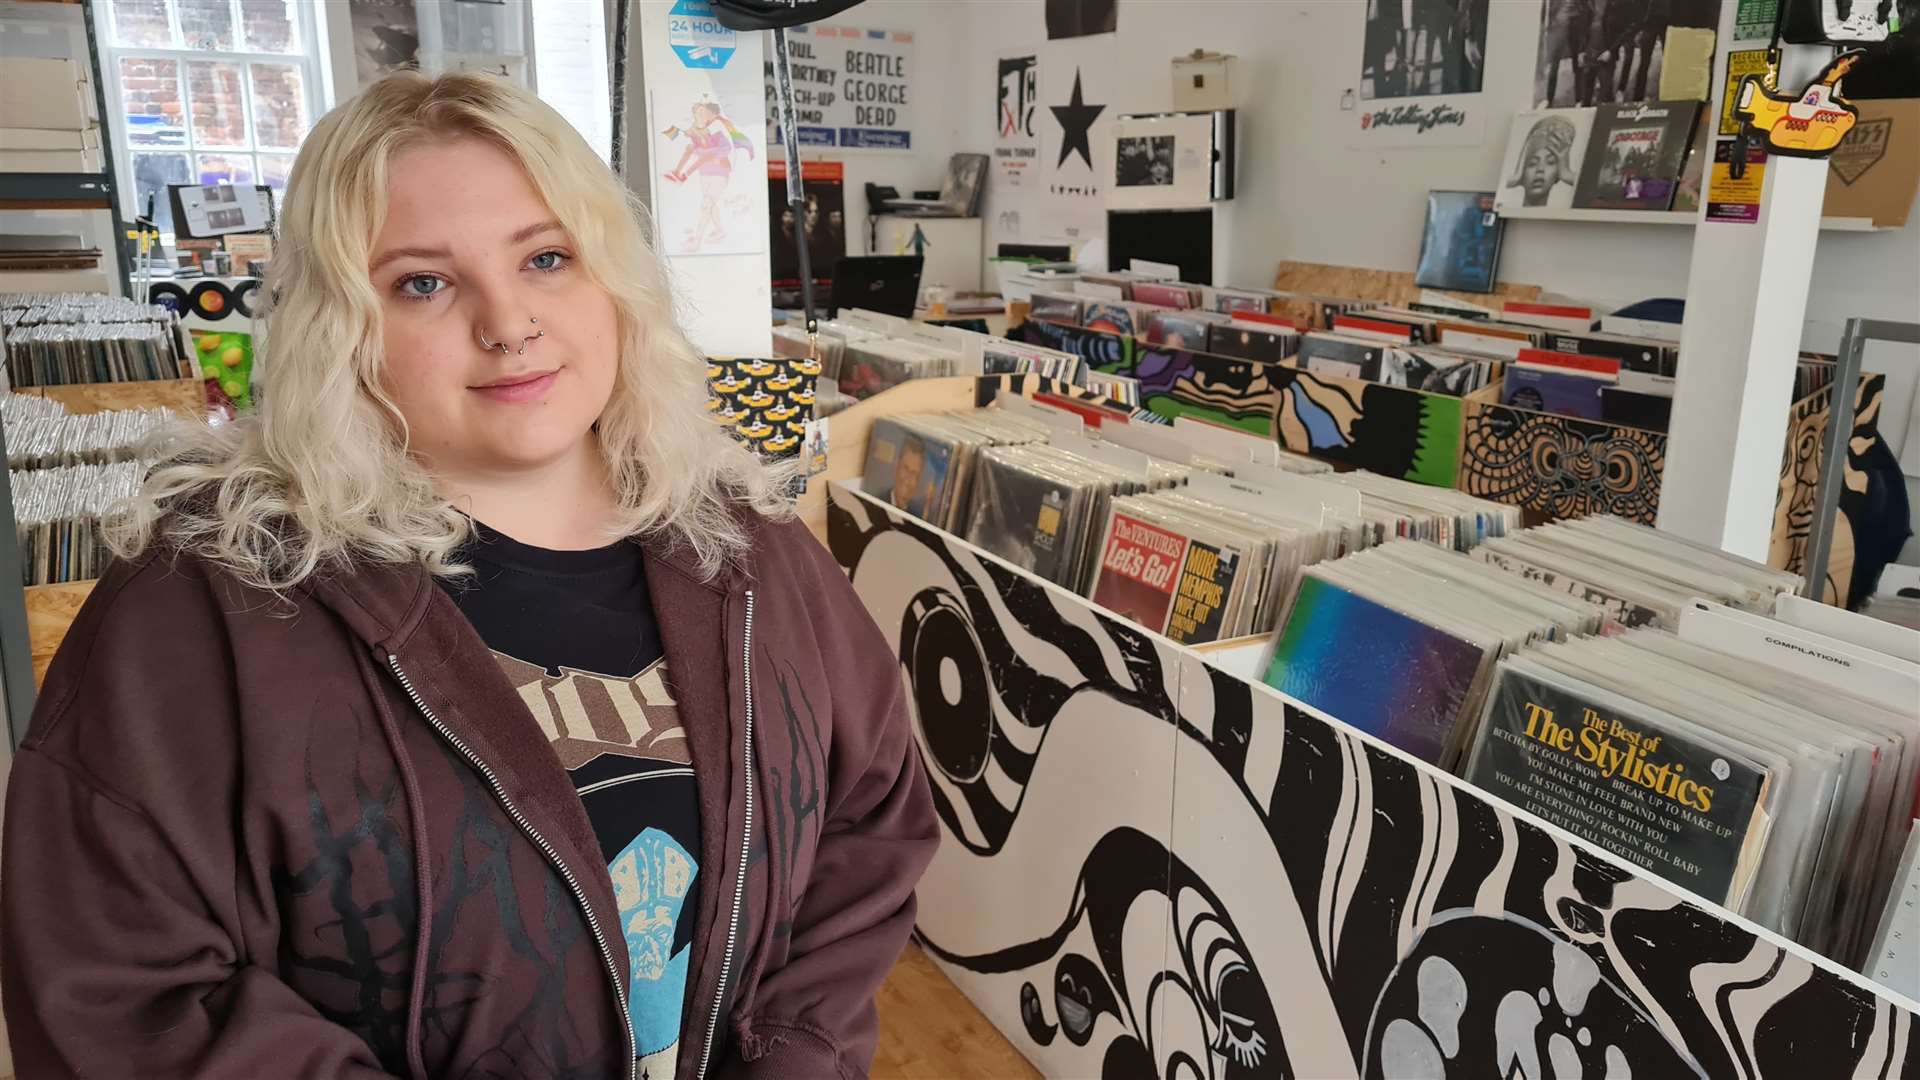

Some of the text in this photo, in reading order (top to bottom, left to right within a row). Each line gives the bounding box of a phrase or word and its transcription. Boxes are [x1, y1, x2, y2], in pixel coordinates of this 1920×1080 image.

[671, 20, 688, 32] 24
[788, 40, 816, 59] AUL
[846, 50, 905, 77] BEATLE
[844, 78, 907, 105] GEORGE
[856, 105, 897, 127] DEAD
[1115, 519, 1182, 559] The VENTURES
[1105, 540, 1177, 589] Let's Go!
[1186, 545, 1218, 581] MORE
[1180, 573, 1224, 608] MEMPHIS
[1765, 637, 1850, 667] COMPILATIONS
[1583, 707, 1662, 753] The Best of
[1523, 703, 1715, 813] The Stylistics
[1493, 727, 1526, 749] BETCHA
[1528, 743, 1541, 754] BY
[1575, 762, 1600, 779] WOW
[1612, 779, 1646, 800] BREAK
[1648, 795, 1663, 807] UP
[1662, 802, 1679, 816] TO
[1680, 810, 1714, 831] MAKE
[1716, 825, 1732, 838] UP
[1527, 756, 1682, 833] YOU MAKE ME FEEL BRAND NEW
[1495, 771, 1514, 786] YOU
[1514, 783, 1535, 796] ARE
[1534, 790, 1594, 825] EVERYTHING
[1644, 842, 1670, 862] ROLL
[1672, 856, 1703, 876] BABY
[1529, 773, 1668, 844] I'M STONE IN LOVE WITH YOU
[1550, 814, 1570, 831] PUT
[1571, 823, 1582, 833] IT
[1581, 828, 1600, 843] ALL
[1600, 836, 1654, 869] TOGETHER
